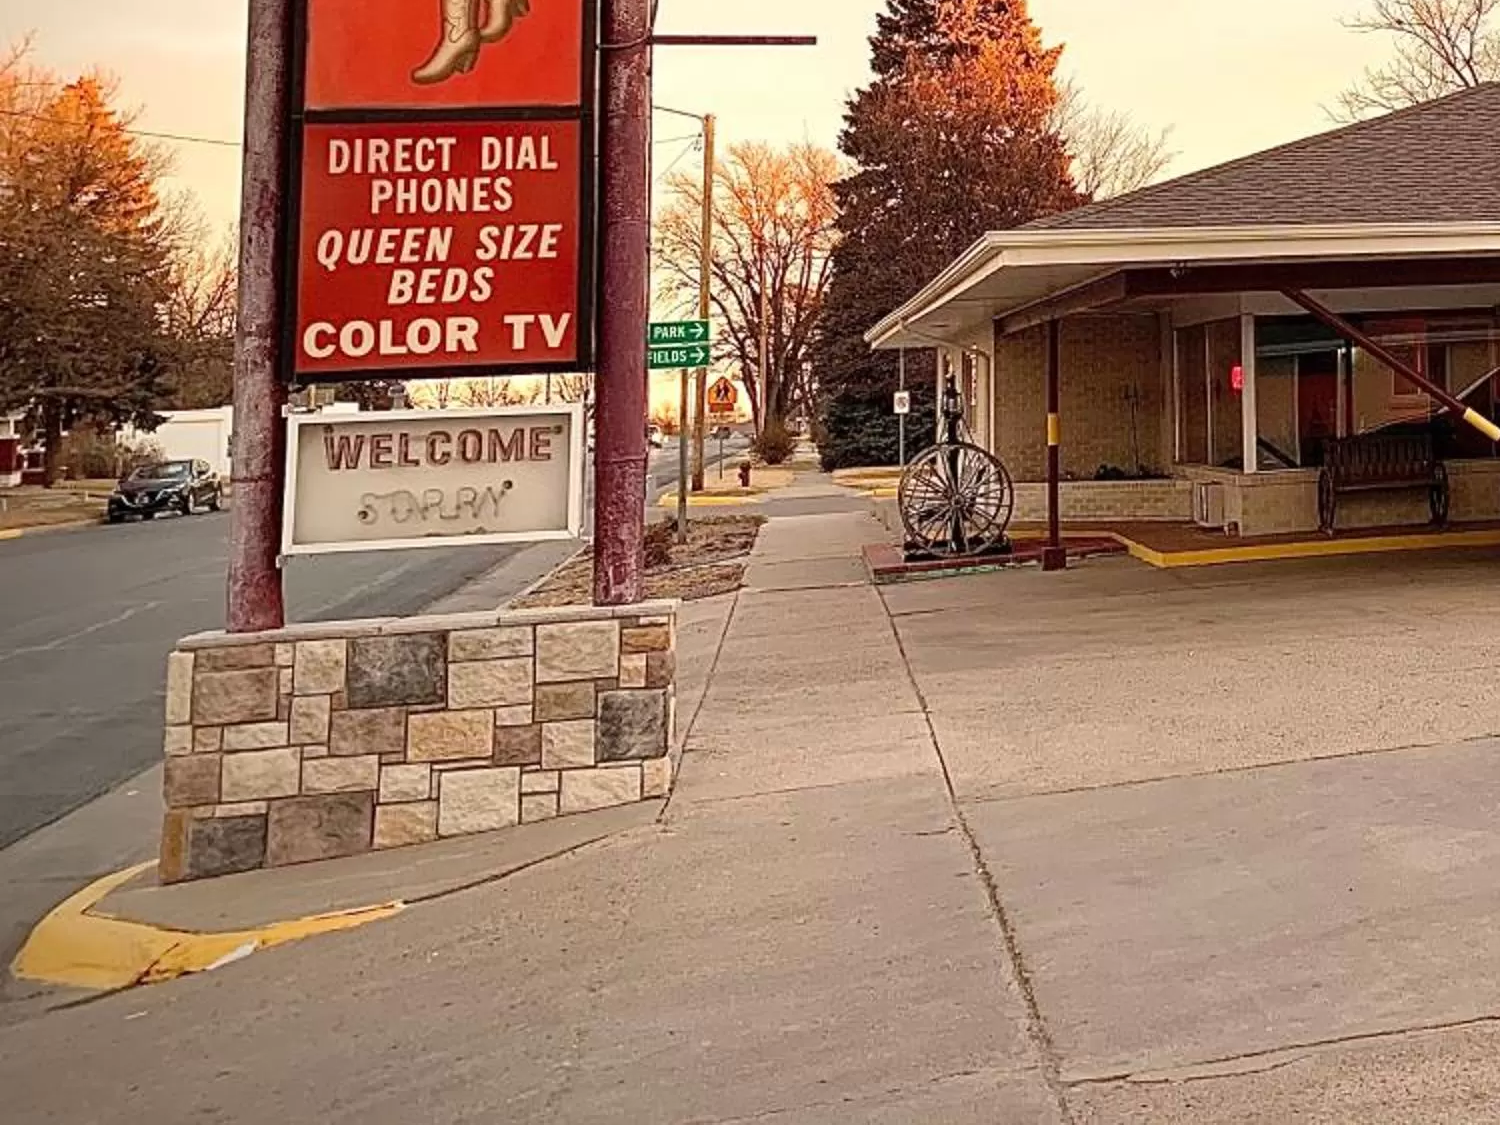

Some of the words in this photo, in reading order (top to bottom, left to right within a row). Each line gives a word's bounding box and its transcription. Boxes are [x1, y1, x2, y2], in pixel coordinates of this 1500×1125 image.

[328, 137, 457, 174] DIRECT
[481, 135, 558, 171] DIAL
[371, 176, 514, 215] PHONES
[316, 226, 453, 271] QUEEN
[475, 223, 563, 261] SIZE
[387, 267, 496, 306] BEDS
[303, 316, 479, 359] COLOR
[503, 312, 572, 351] TV
[653, 325, 686, 339] PARK
[324, 426, 555, 471] WELCOME
